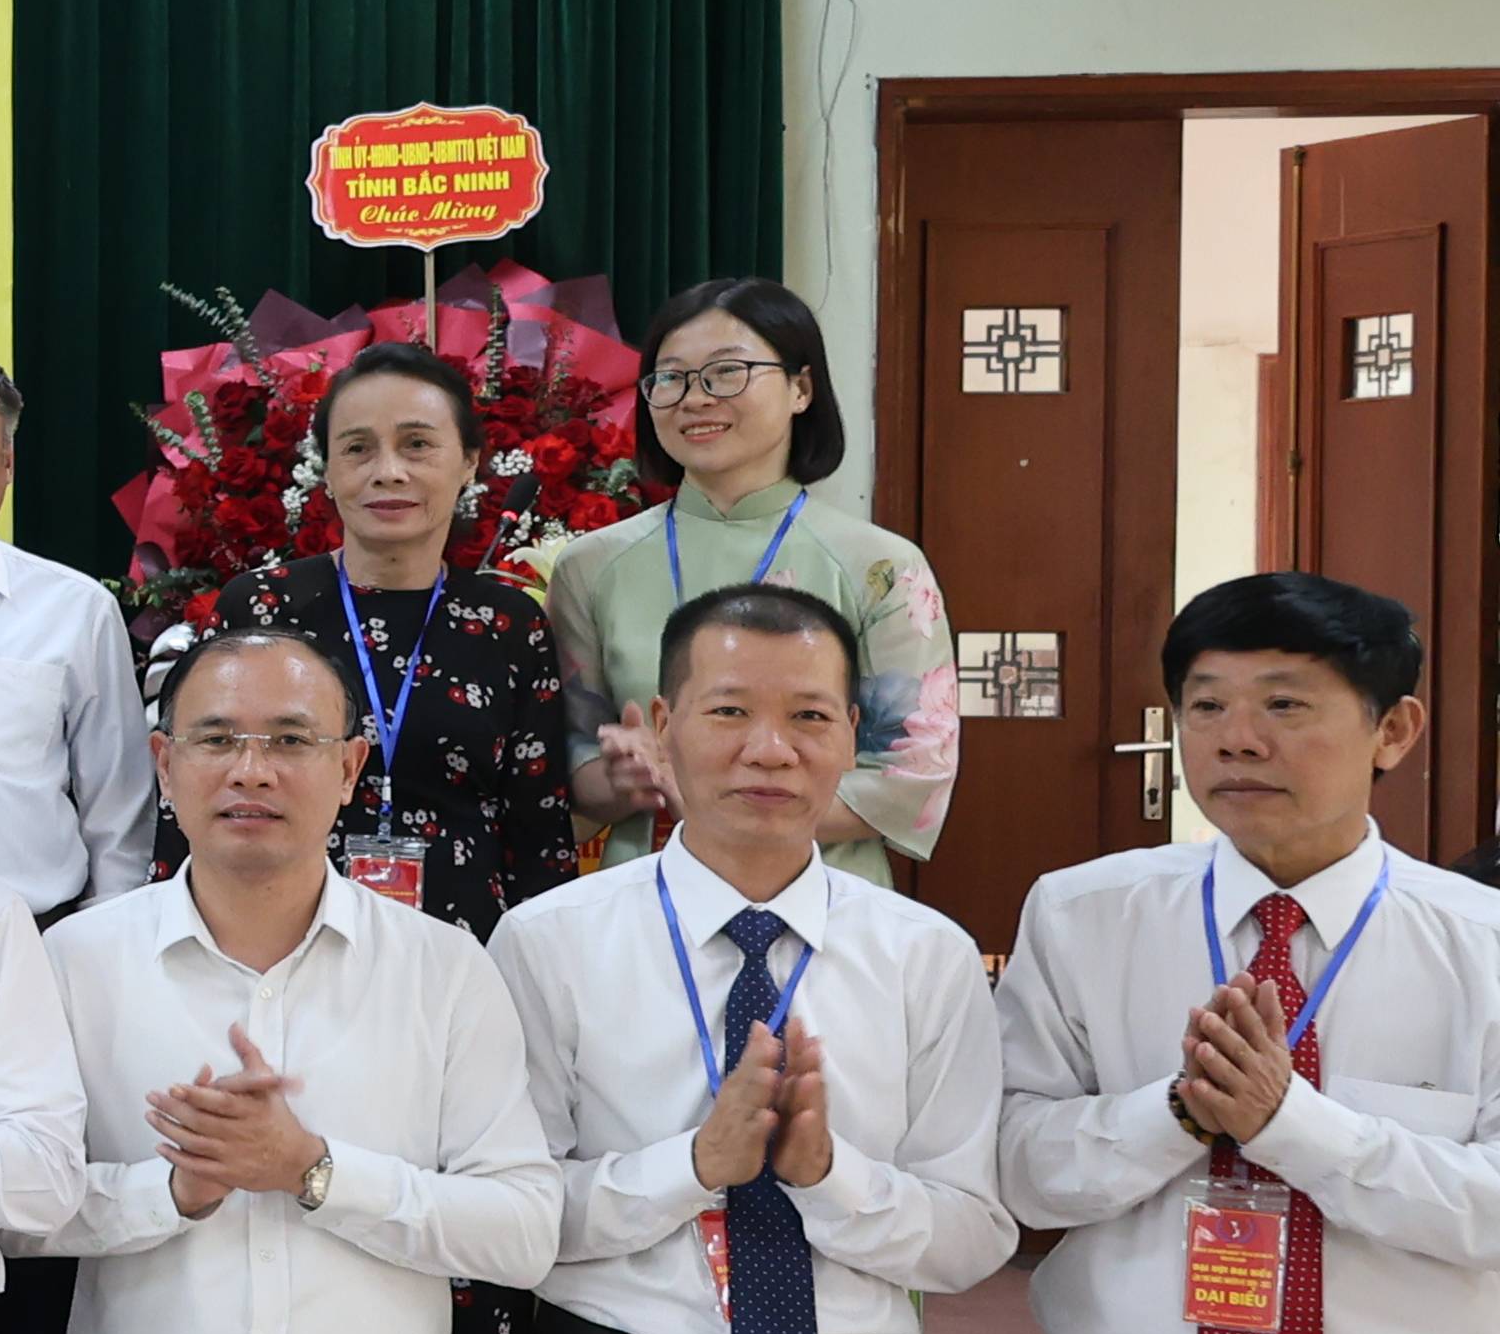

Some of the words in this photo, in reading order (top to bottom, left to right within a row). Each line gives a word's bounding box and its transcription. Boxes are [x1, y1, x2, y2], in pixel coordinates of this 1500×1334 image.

[346, 172, 397, 198] TỈNH
[402, 170, 448, 196] BẮC
[453, 170, 511, 192] NINH
